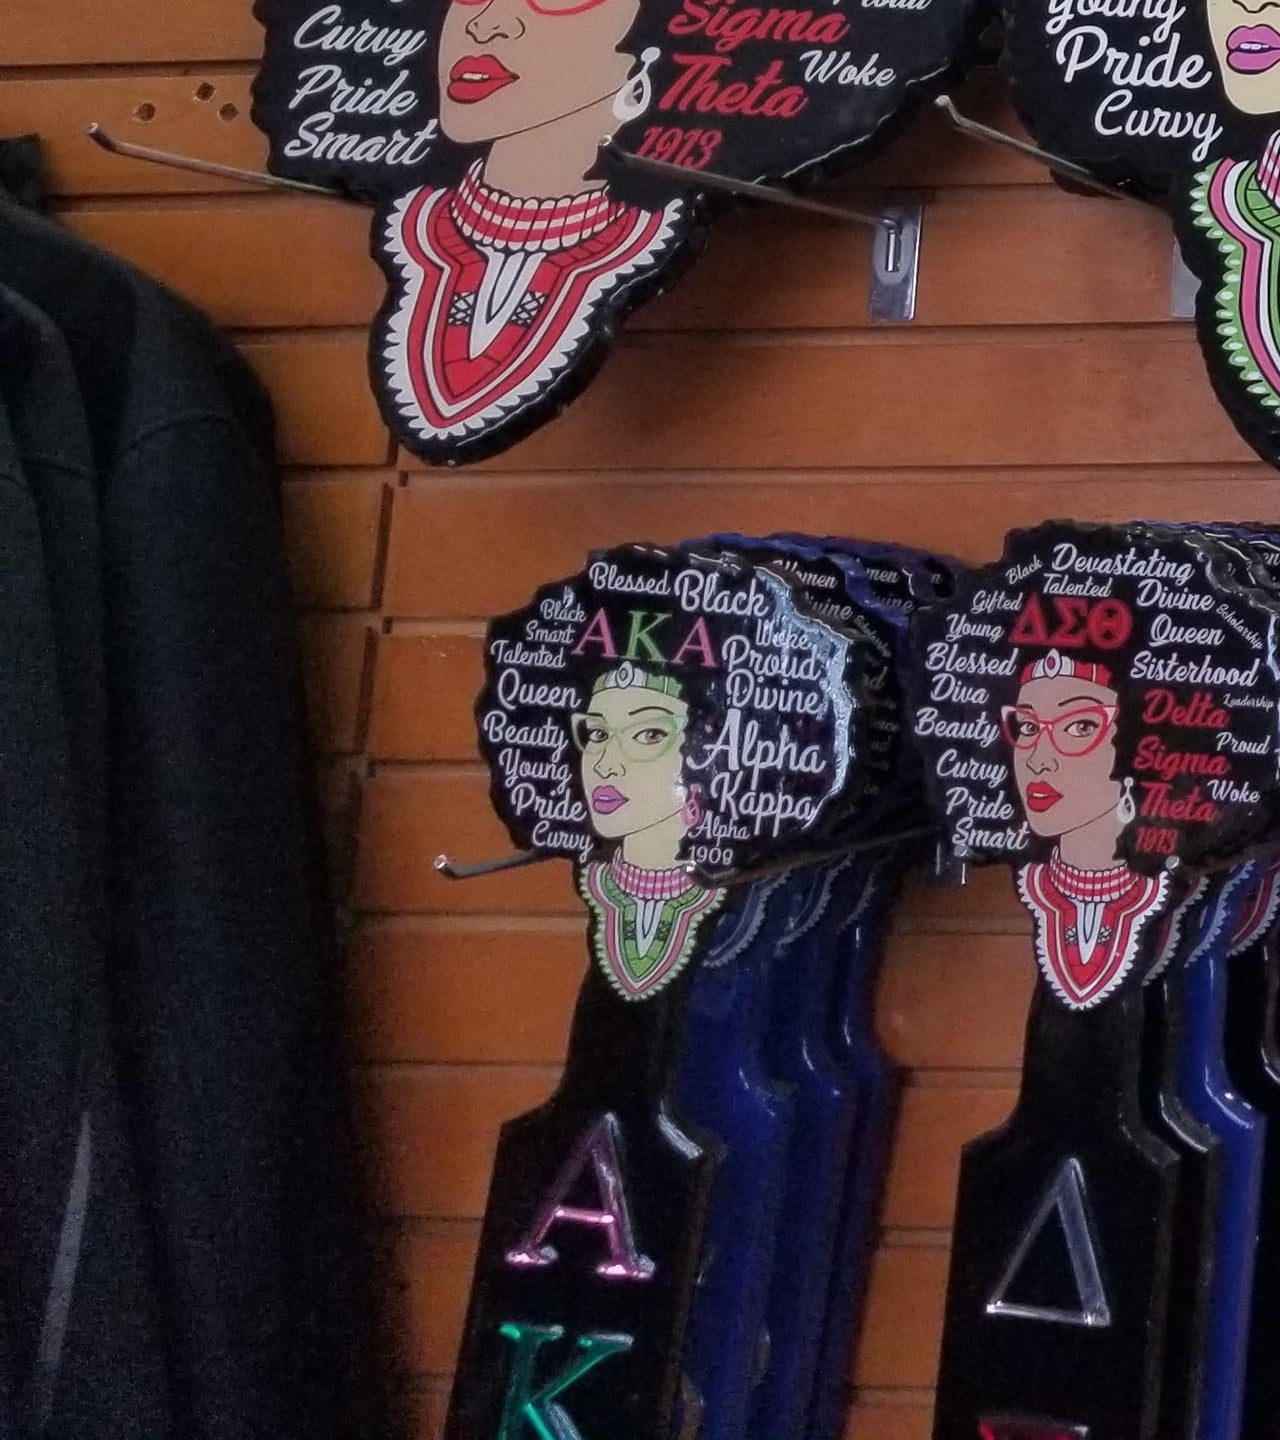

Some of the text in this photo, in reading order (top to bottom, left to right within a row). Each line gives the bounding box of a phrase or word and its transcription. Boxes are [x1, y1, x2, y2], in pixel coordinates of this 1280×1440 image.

[294, 7, 426, 58] Curvy
[800, 50, 896, 86] Woke
[1056, 26, 1212, 88] Pride
[289, 64, 419, 117] Pride
[659, 54, 808, 117] Theta
[284, 111, 439, 166] Smart
[1095, 89, 1223, 162] Curvy
[636, 127, 723, 169] 1913
[589, 562, 671, 595] Blessed
[1005, 555, 1042, 584] Black
[1052, 543, 1195, 586] Devastating
[674, 570, 769, 617] Black
[971, 590, 1023, 614] Gifted
[1044, 573, 1112, 597] Talented
[1137, 579, 1215, 611] Divine
[540, 599, 586, 619] Black
[946, 614, 1004, 642] Young
[1216, 604, 1263, 649] Scholarship
[526, 620, 575, 644] Smart
[1149, 614, 1225, 647] Queen
[491, 640, 566, 668] Talented
[722, 635, 821, 680] Proud
[926, 642, 1018, 675] Blessed
[1131, 651, 1260, 686] Sisterhood
[498, 668, 581, 710] Queen
[726, 669, 820, 710] Divine
[931, 673, 989, 704] Diva
[1224, 694, 1273, 711] Leadership
[915, 707, 1000, 747] Beauty
[1143, 689, 1228, 728] Delta
[483, 710, 568, 760] Beauty
[686, 708, 826, 790] Alpha
[1216, 732, 1270, 754] Proud
[499, 748, 572, 793] Young
[937, 749, 1008, 788] Curvy
[1133, 735, 1232, 777] Sigma
[511, 783, 587, 822] Pride
[711, 771, 819, 837] Kappa
[946, 787, 1014, 820] Pride
[1140, 782, 1217, 821] Theta
[1207, 779, 1260, 803] Woke
[532, 820, 593, 863] Curvy
[688, 810, 750, 846] Alpha
[953, 817, 1030, 850] Smart
[505, 1113, 654, 1279] A
